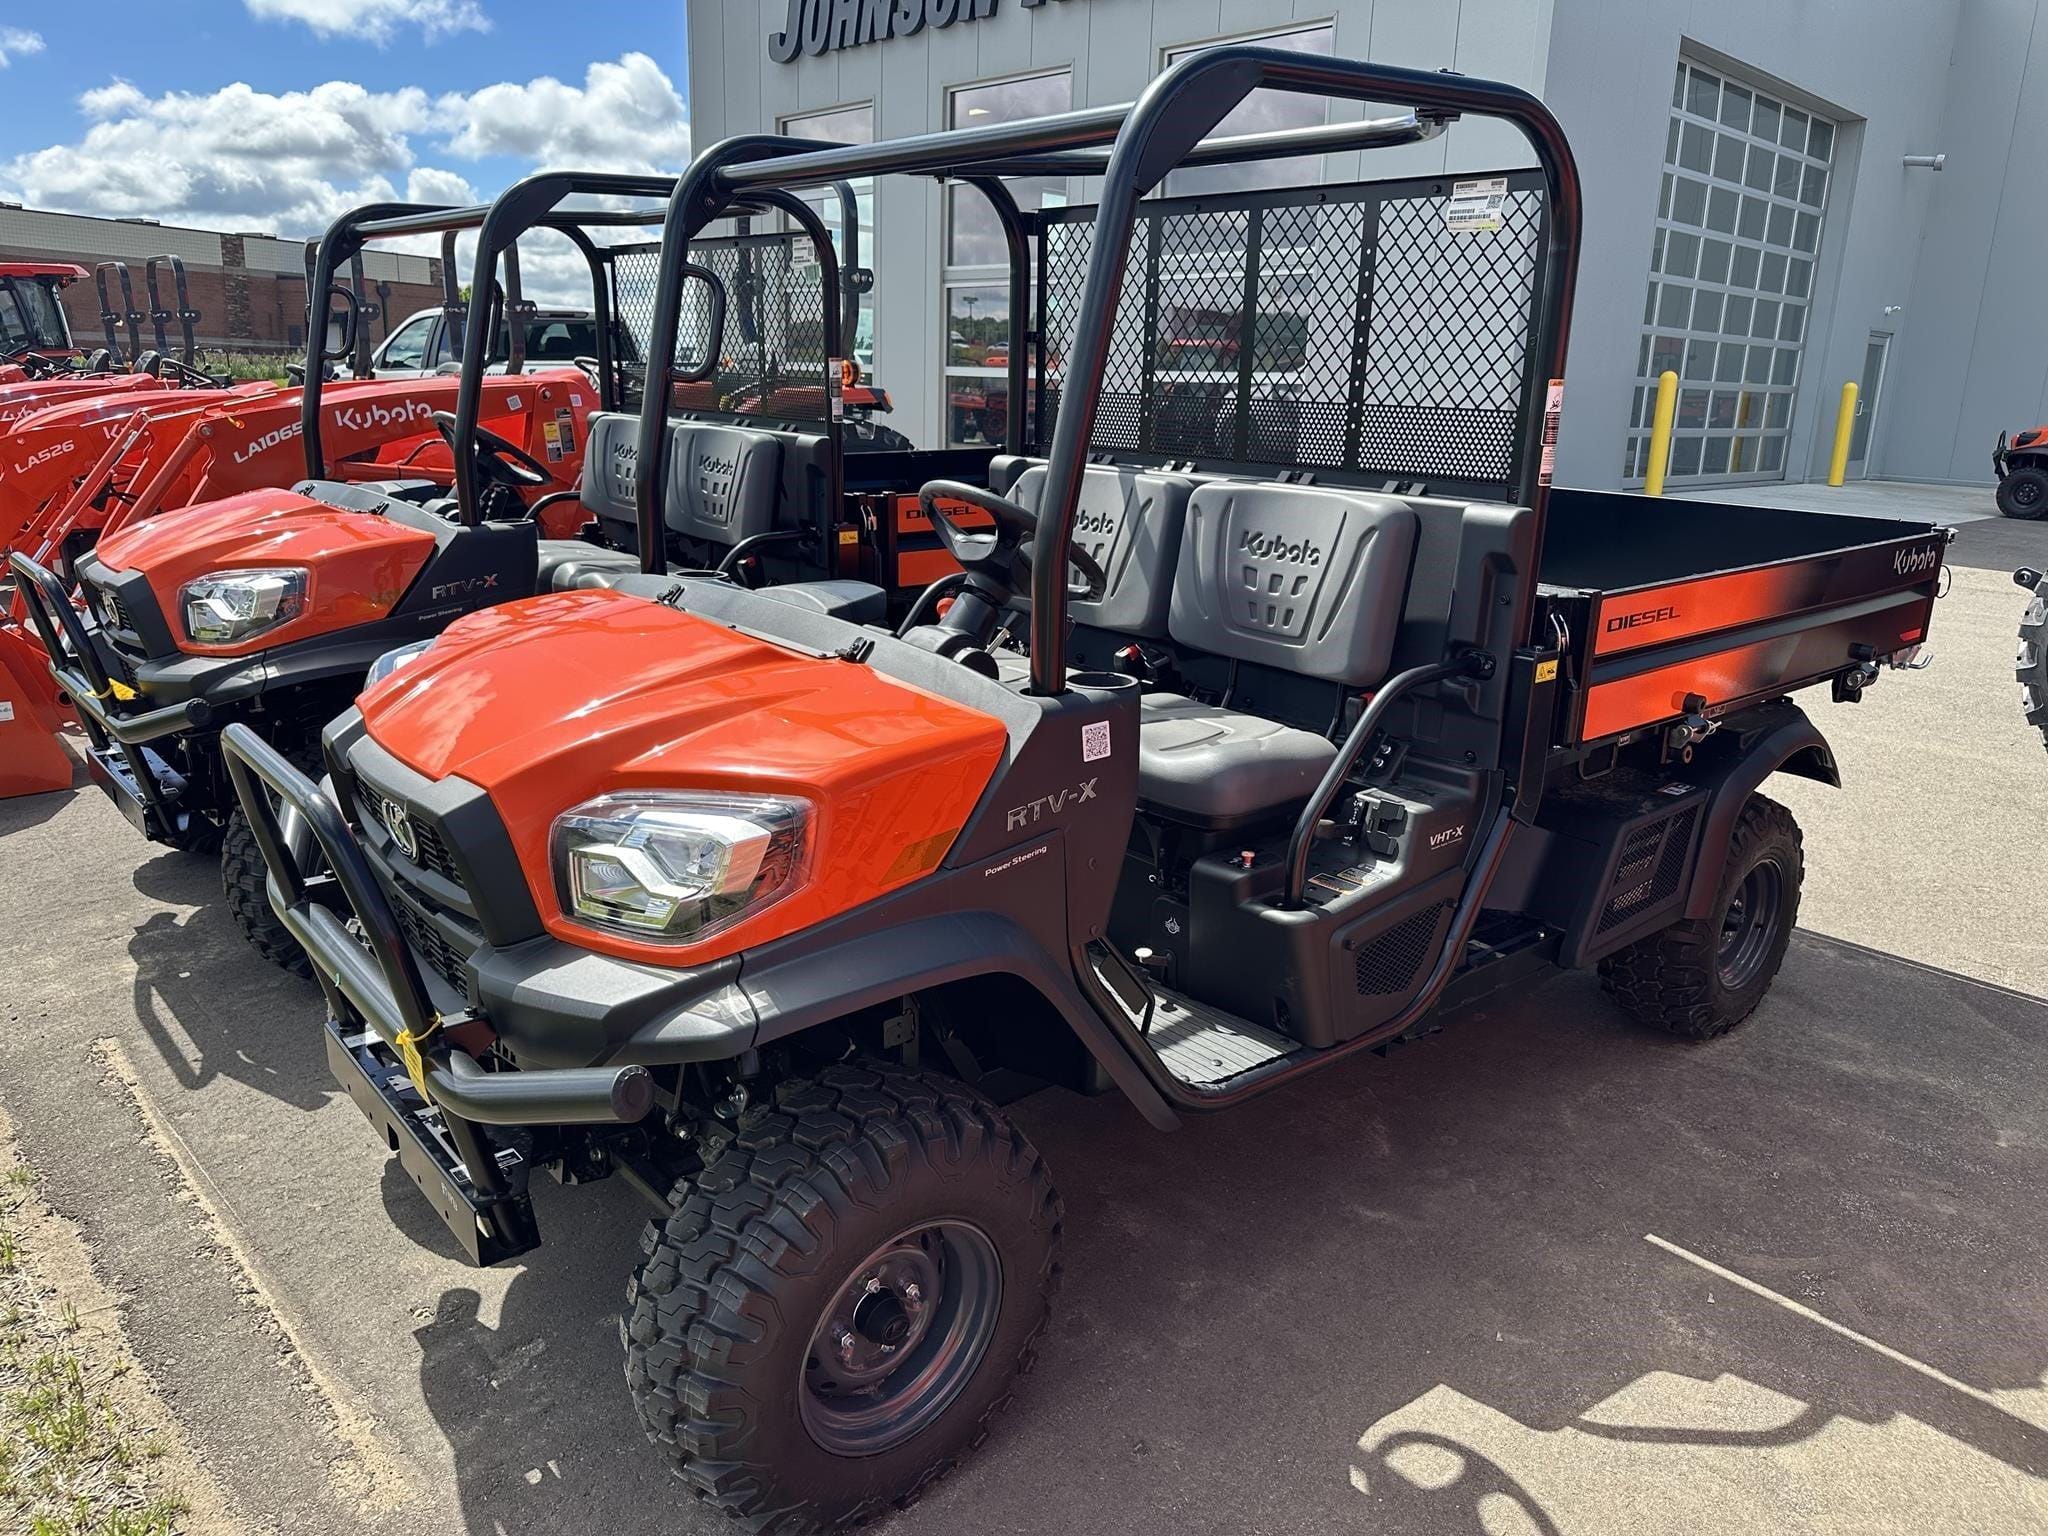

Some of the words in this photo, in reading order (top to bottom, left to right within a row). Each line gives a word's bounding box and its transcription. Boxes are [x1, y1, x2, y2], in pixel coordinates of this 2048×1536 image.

[335, 399, 433, 431] Kubota
[233, 420, 303, 464] LA1065
[14, 440, 75, 474] LA526
[906, 506, 977, 519] DISEL
[1072, 509, 1114, 536] ubota
[1240, 530, 1321, 567] Kubota
[1893, 549, 1936, 576] Kubota
[432, 573, 499, 600] RTV-X
[1606, 606, 1681, 633] DIESEL
[1007, 777, 1099, 832] RTV-X
[1430, 825, 1464, 846] VHT-X
[985, 859, 1011, 877] Power
[1012, 845, 1048, 866] Steering
